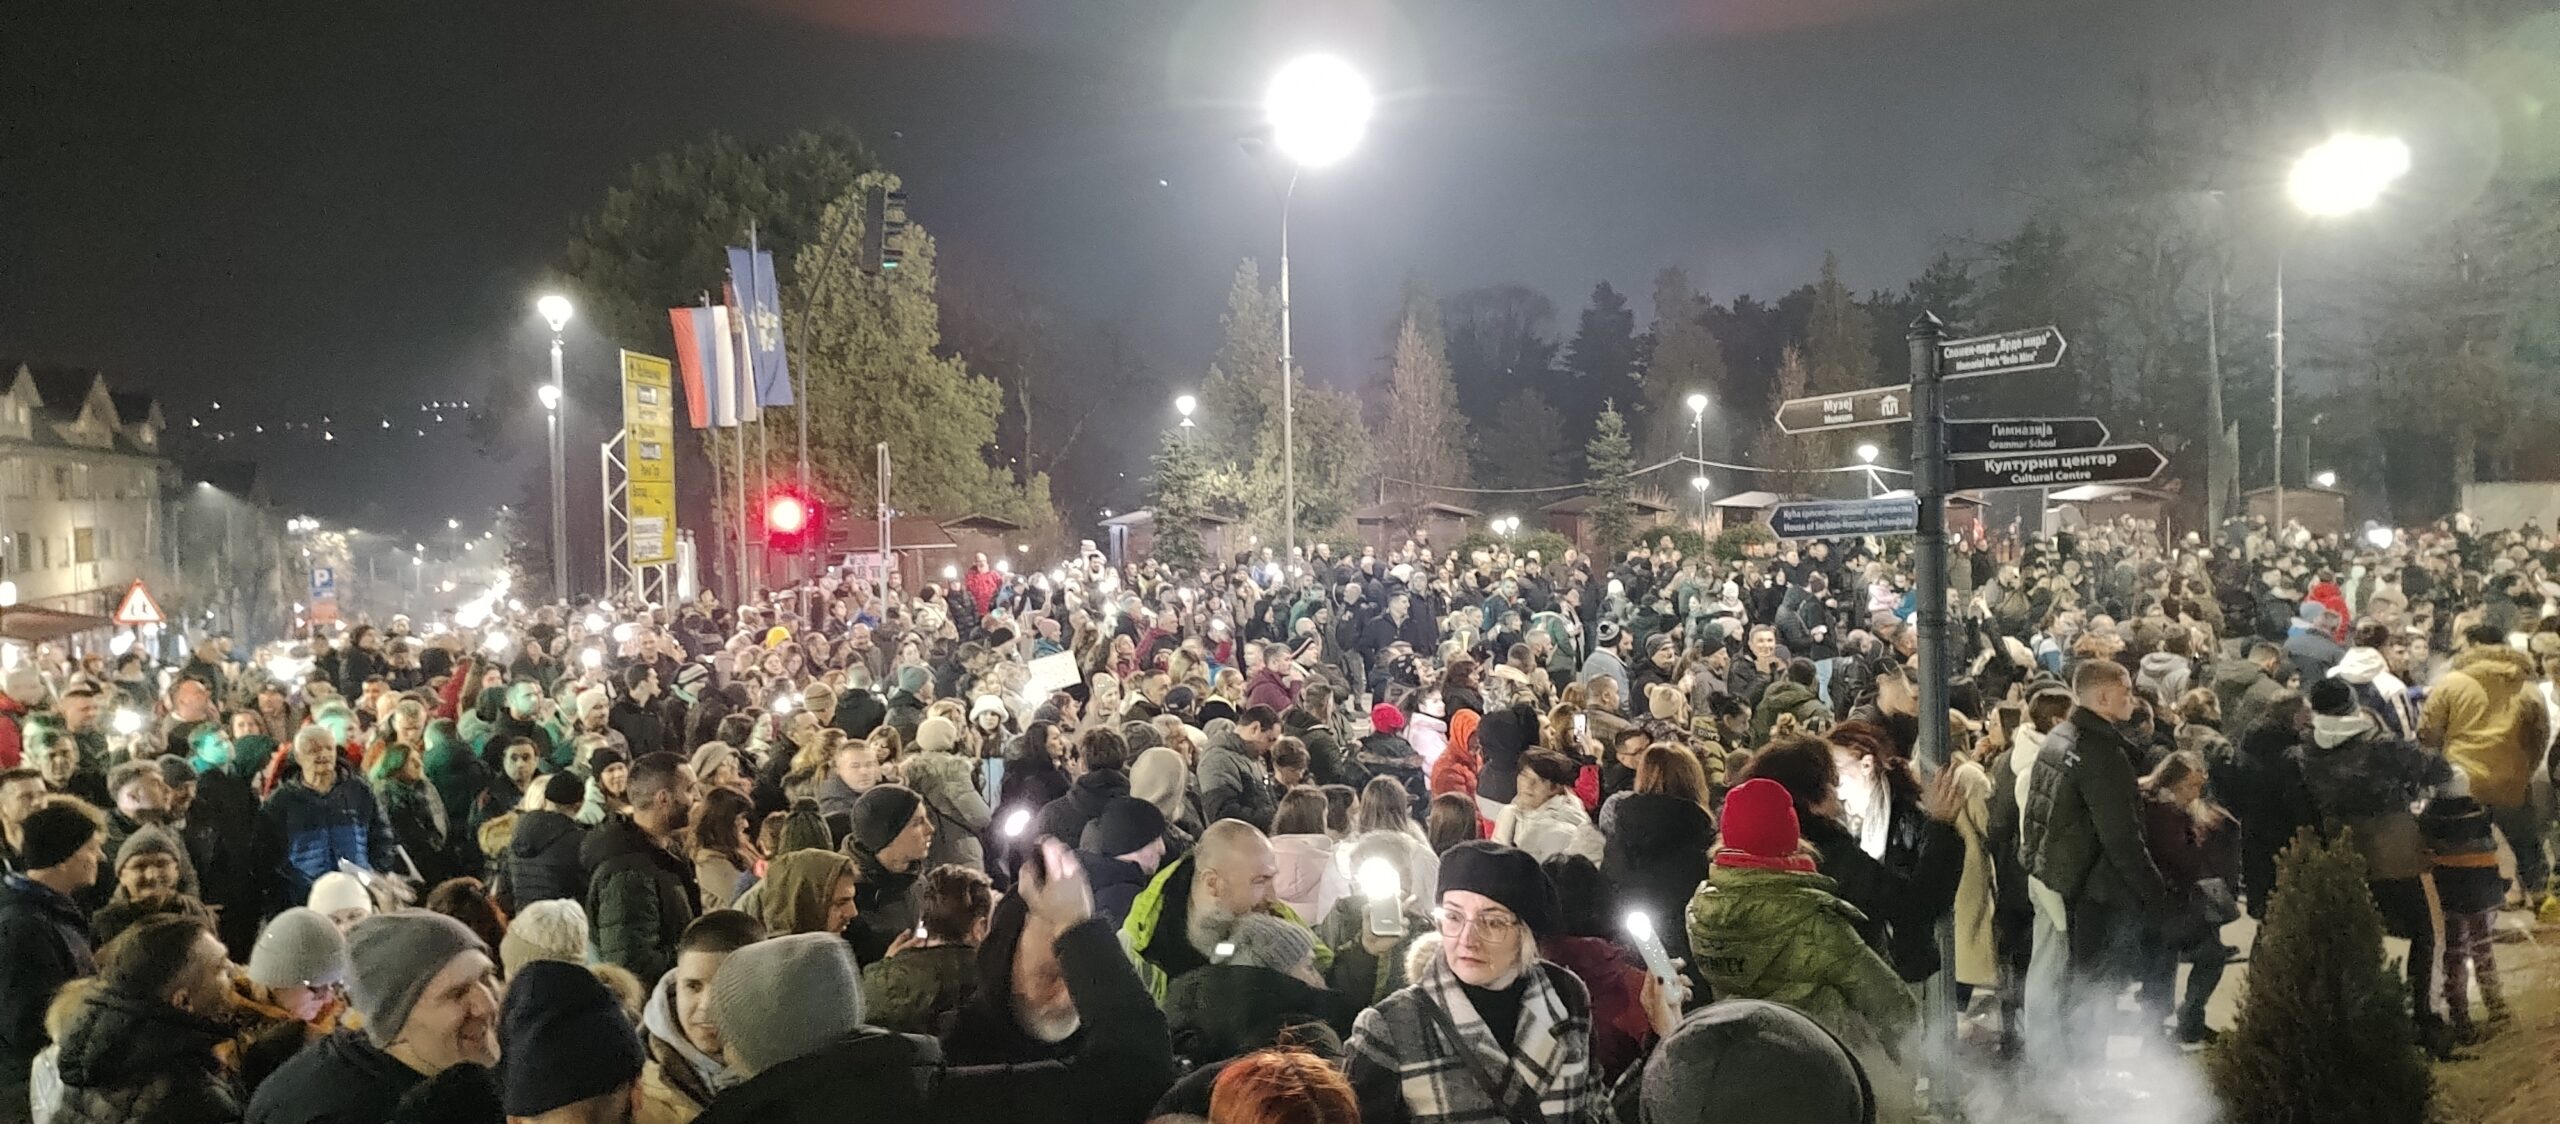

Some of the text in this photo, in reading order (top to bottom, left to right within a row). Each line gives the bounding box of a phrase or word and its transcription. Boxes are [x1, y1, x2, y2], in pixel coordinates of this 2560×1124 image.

[1823, 396, 1853, 414] Музеј
[1823, 413, 1854, 424] Museum
[1991, 422, 2053, 438] Гимназија
[1988, 437, 2057, 449] Grammar School
[1984, 453, 2118, 475] Културни центар
[2010, 470, 2092, 484] Cultural Centre
[314, 569, 330, 587] P
